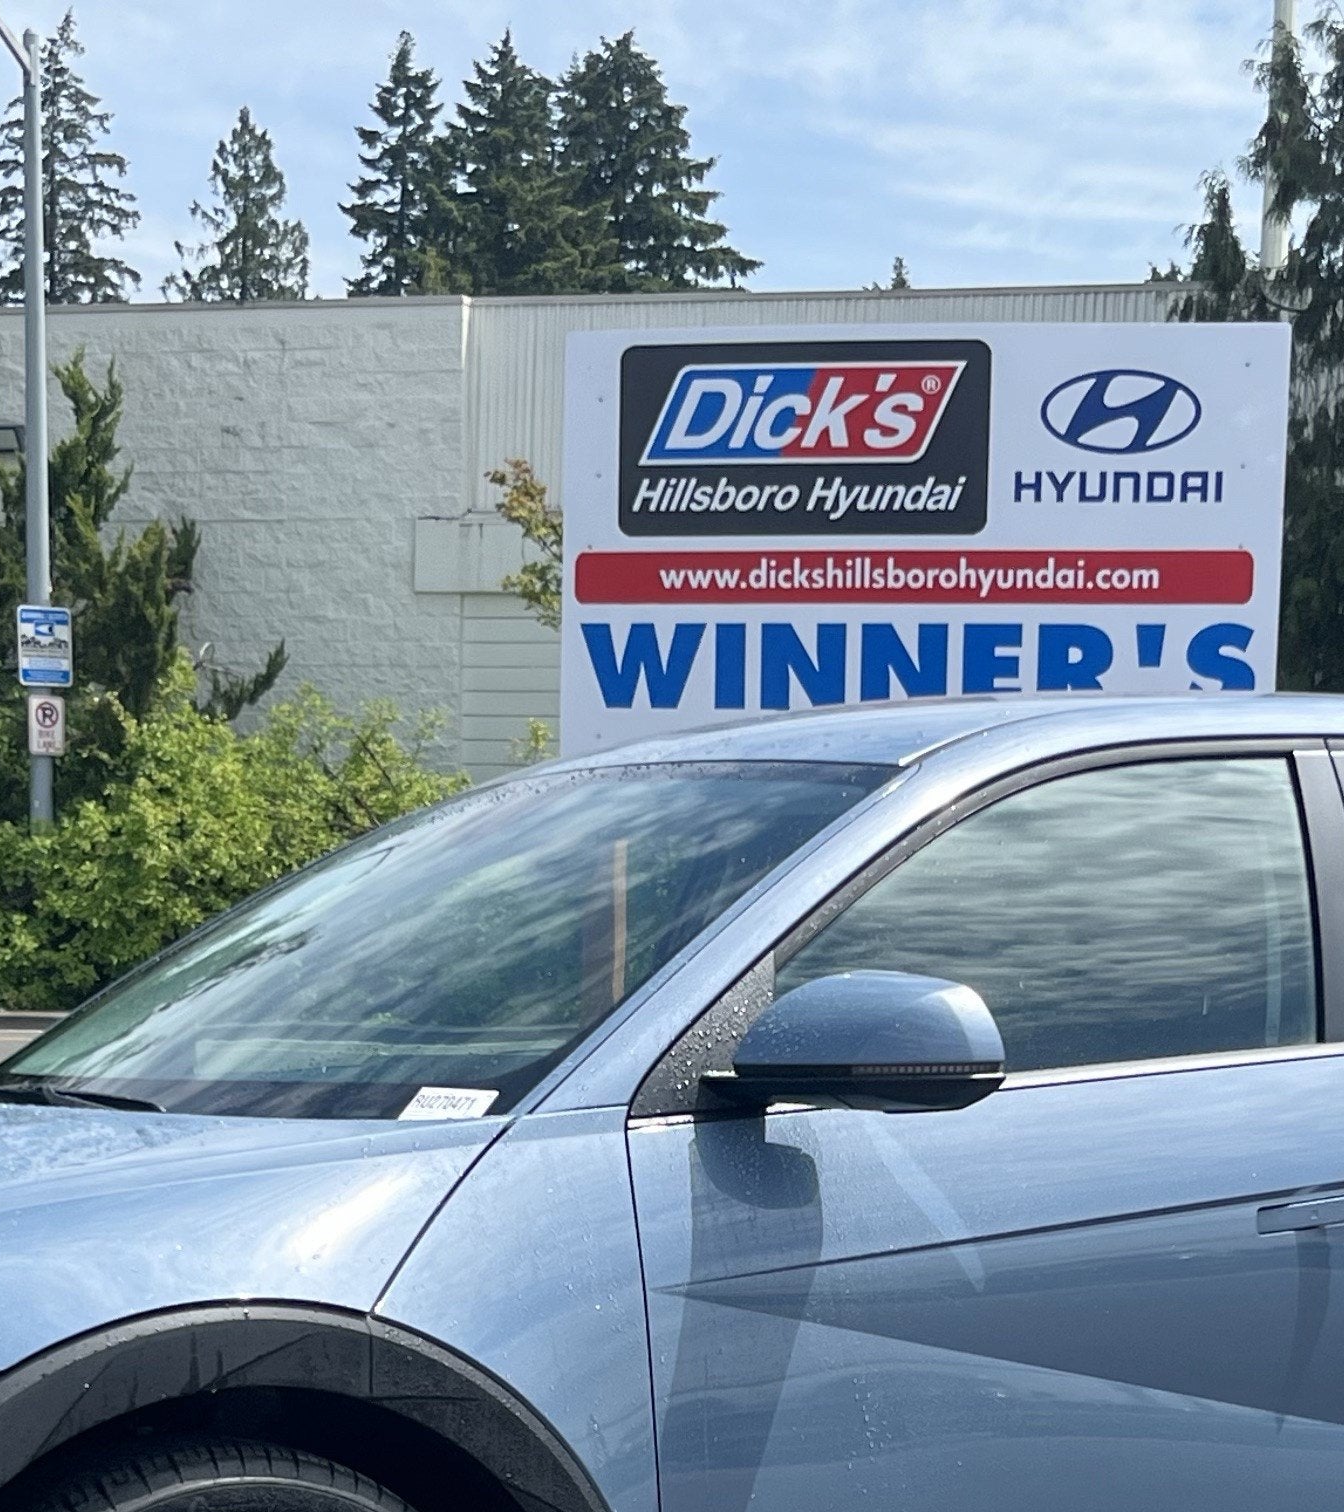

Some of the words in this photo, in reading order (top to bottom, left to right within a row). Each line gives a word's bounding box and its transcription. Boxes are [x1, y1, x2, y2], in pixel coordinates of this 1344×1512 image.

[664, 373, 922, 451] Dick's
[631, 477, 801, 513] Hillsboro
[808, 476, 968, 519] Hyundai
[1013, 471, 1224, 503] HYUNDAI
[659, 557, 1161, 598] www.dickshillsborohyundai.com
[581, 622, 1257, 710] WINNER'S
